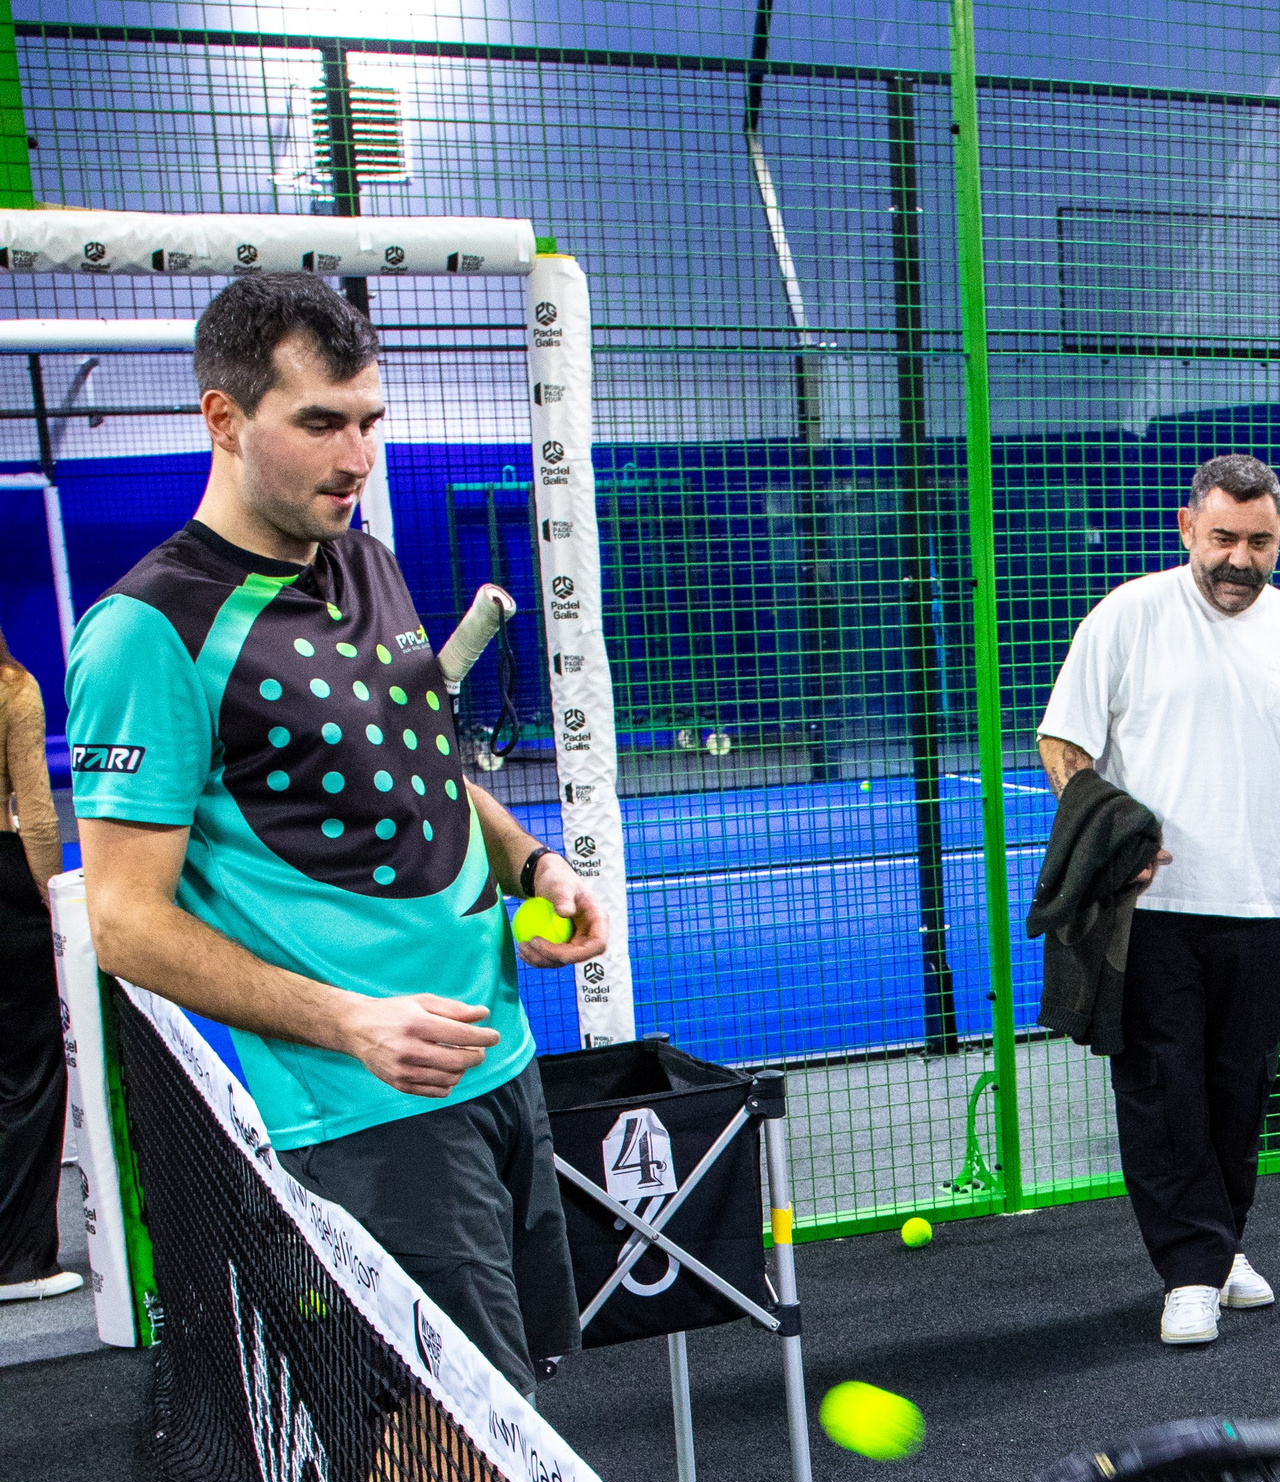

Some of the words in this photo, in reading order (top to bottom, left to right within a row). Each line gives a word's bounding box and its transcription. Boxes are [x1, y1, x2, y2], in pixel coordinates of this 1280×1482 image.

[533, 328, 562, 338] Padel
[535, 338, 561, 347] Galis
[540, 466, 570, 475] Padel
[543, 476, 568, 485] Galis
[551, 601, 580, 610] Padel
[553, 610, 579, 620] Galis
[563, 733, 591, 742] Padel
[565, 742, 590, 751] Galis
[573, 859, 601, 868] Padel
[582, 986, 610, 994] Padel
[584, 994, 609, 1003] Galis
[612, 1117, 668, 1189] 4
